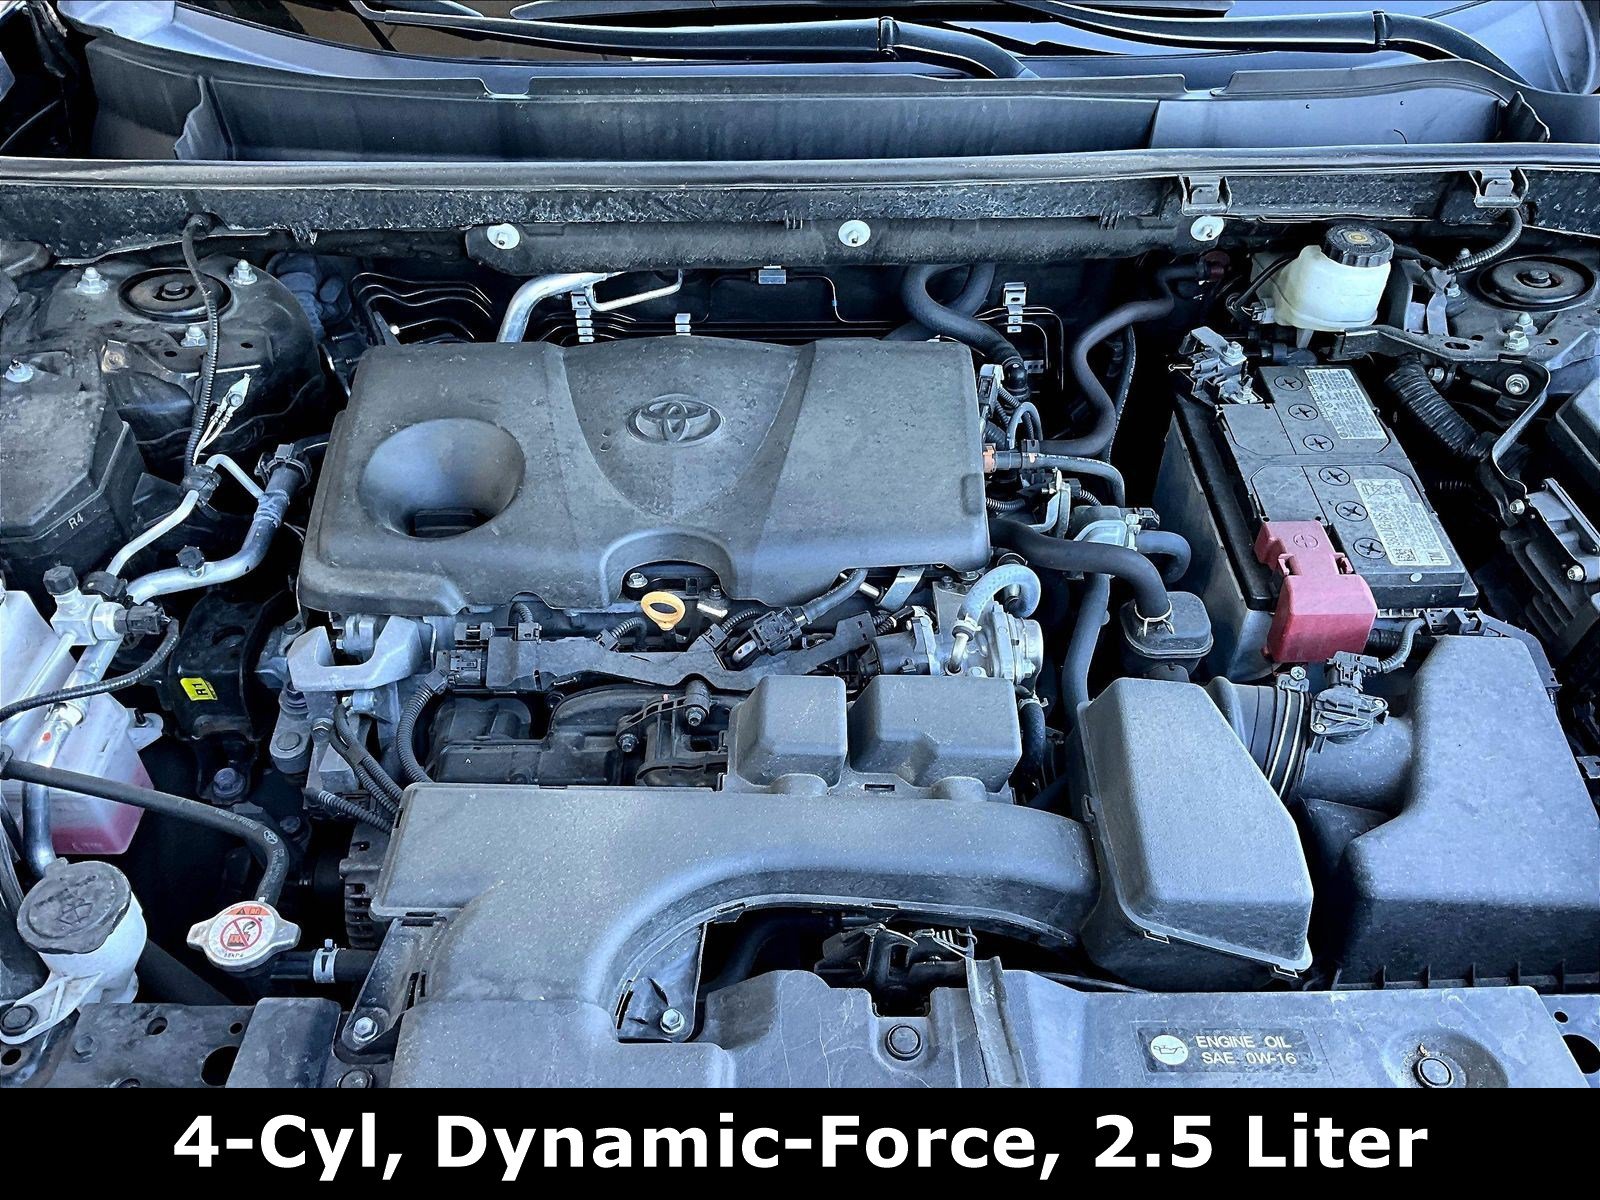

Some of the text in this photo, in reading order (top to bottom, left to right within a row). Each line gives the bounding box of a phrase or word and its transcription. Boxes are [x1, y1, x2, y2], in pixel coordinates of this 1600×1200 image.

[68, 512, 84, 530] R4
[1196, 1036, 1292, 1049] ENGINE OIL
[1202, 1052, 1298, 1065] SAE 0W-16
